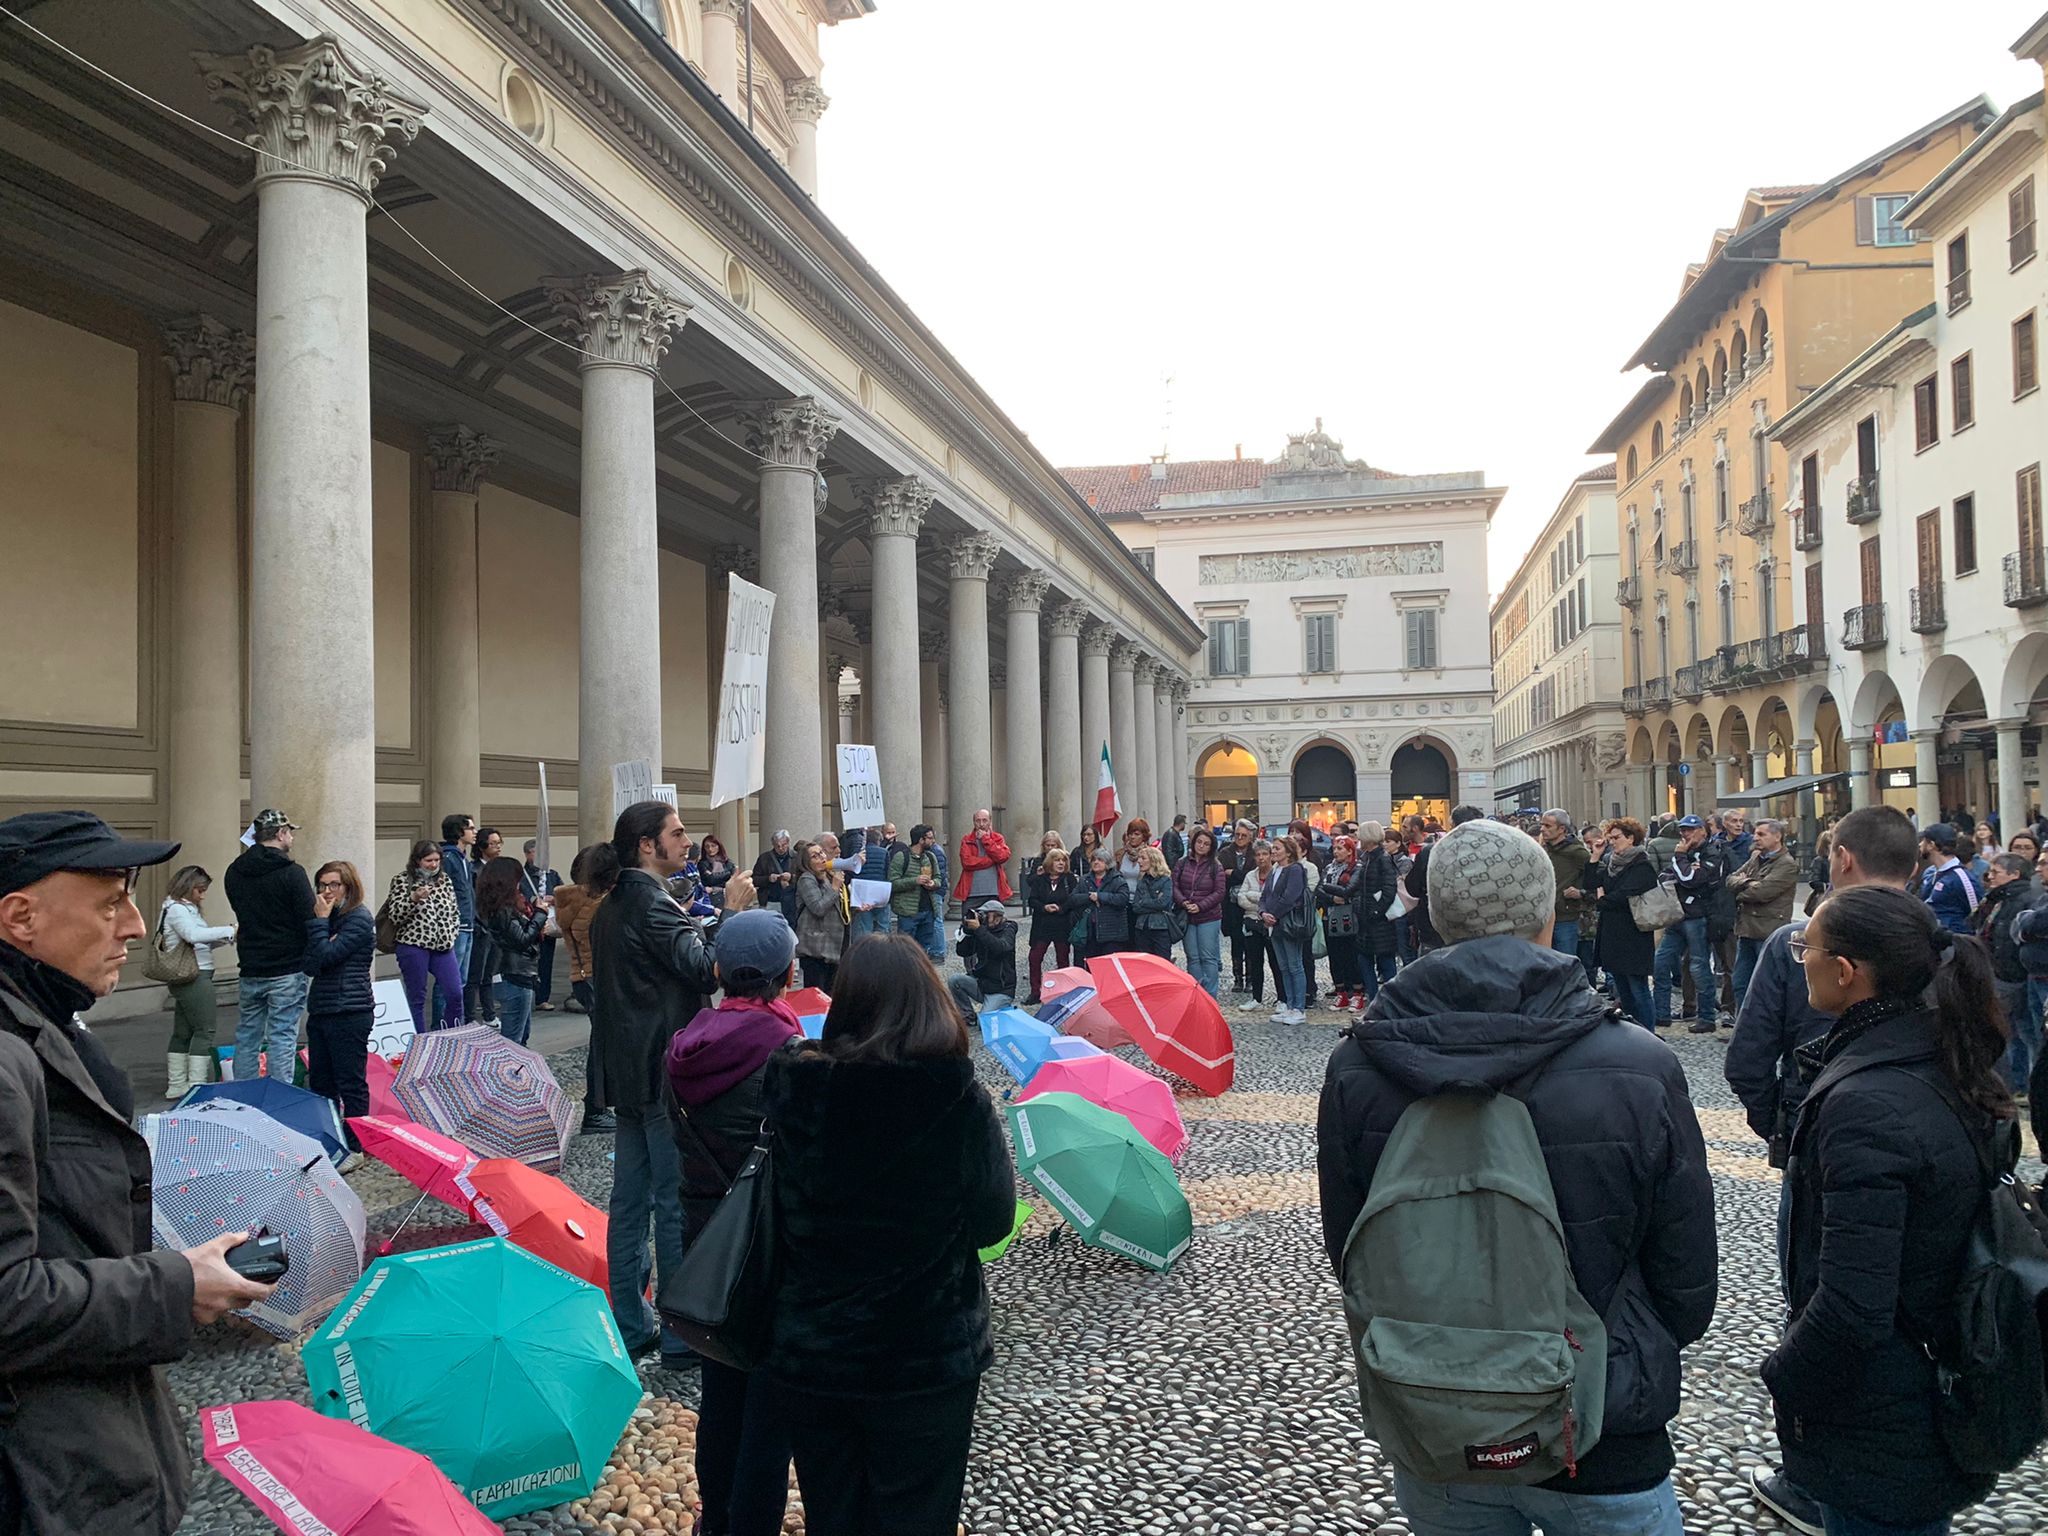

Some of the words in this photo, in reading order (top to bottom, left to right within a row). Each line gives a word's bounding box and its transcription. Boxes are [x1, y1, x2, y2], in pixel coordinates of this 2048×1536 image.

[842, 747, 871, 774] STOP
[840, 783, 882, 813] DITTATURA
[246, 1266, 268, 1274] SONY
[332, 1287, 378, 1336] LAVORO
[336, 1351, 353, 1367] IN
[1476, 1445, 1532, 1462] EASTPAK
[228, 1449, 285, 1506] ESERCITARE
[282, 1497, 300, 1514] IL
[475, 1489, 483, 1507] E
[485, 1464, 580, 1502] APPLICAZIONI
